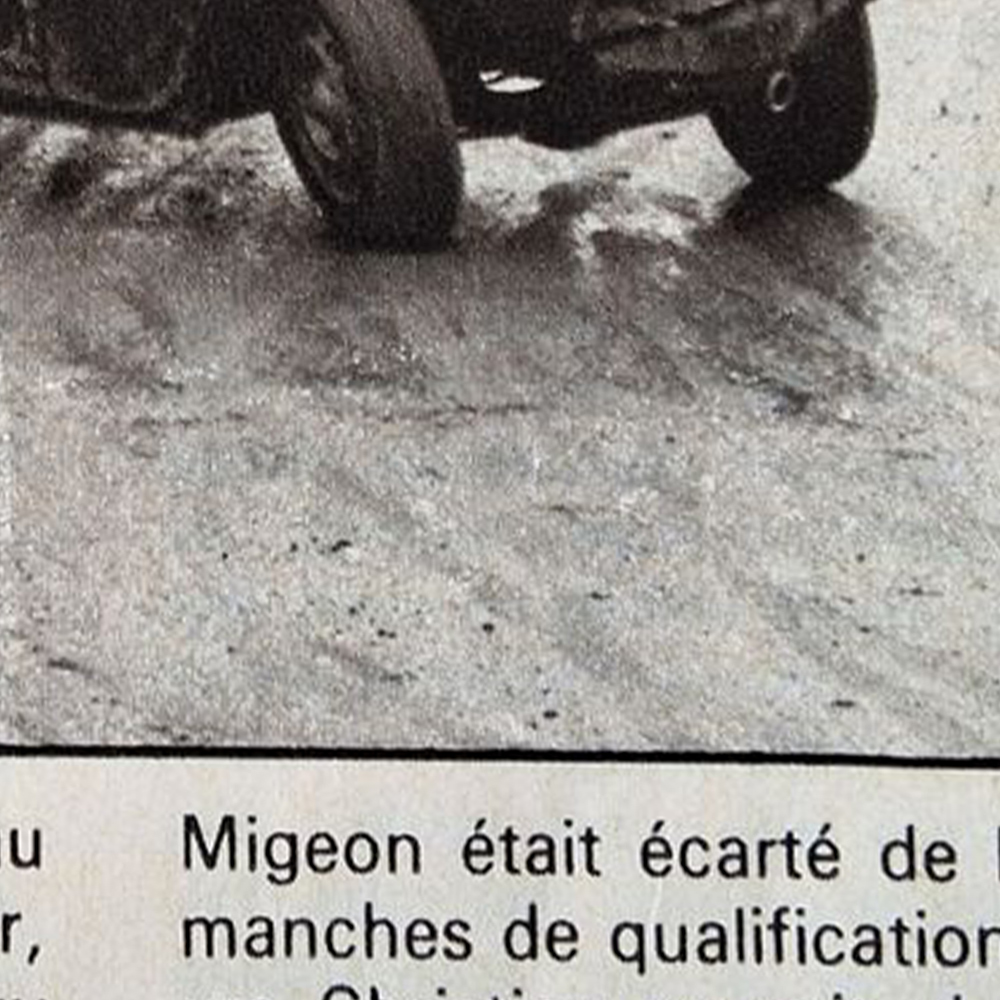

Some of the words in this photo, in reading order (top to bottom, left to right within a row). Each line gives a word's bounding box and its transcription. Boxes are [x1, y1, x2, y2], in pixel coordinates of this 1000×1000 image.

[182, 813, 422, 887] Migeon
[461, 817, 602, 878] était
[639, 819, 841, 882] écarté
[880, 823, 958, 885] de
[182, 900, 474, 962] manches
[502, 901, 580, 963] de
[610, 905, 1000, 977] qualification
